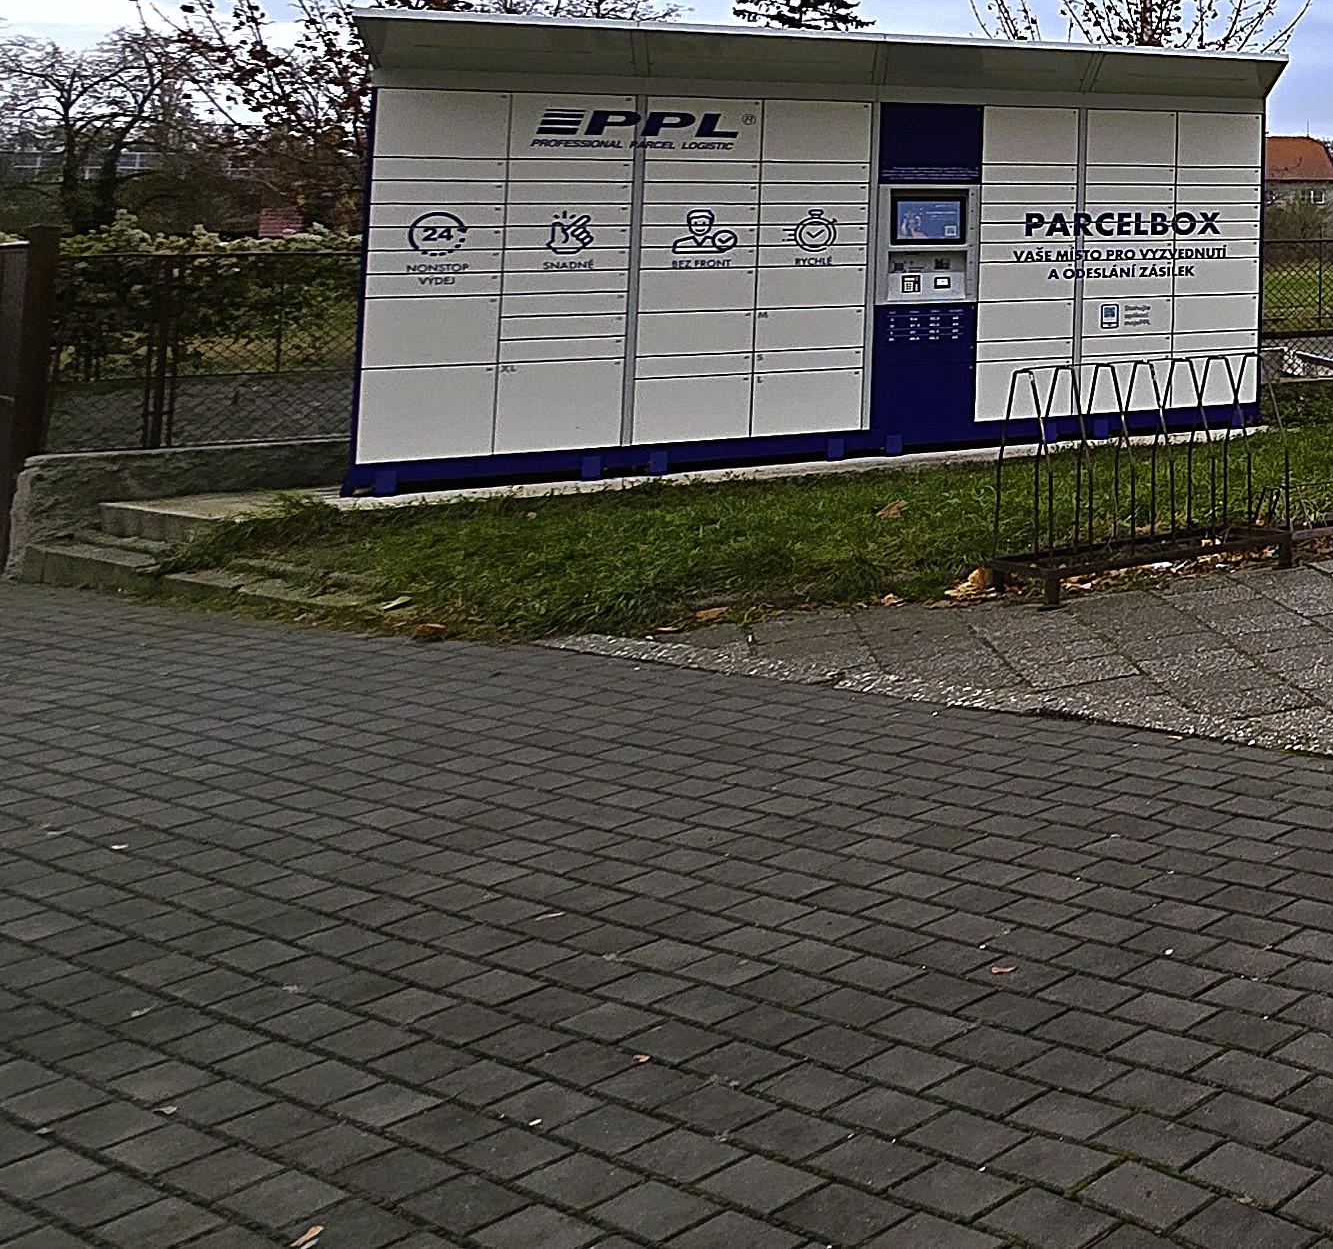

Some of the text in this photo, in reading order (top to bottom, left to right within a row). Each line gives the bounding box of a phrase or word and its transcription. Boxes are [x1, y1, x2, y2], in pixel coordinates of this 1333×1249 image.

[584, 110, 739, 138] PPL
[530, 139, 734, 151] PROFESSIONAL PARCEL LOGISTIC
[1025, 212, 1220, 236] PARCELBOX
[422, 227, 454, 241] 24
[1013, 244, 1228, 262] VAŠE MÍSTO PRO VYZVEDNUTÍ
[543, 259, 594, 269] SNADNÉ
[672, 259, 731, 268] BEZ FRONT
[795, 256, 833, 265] RYCHLÉ
[406, 263, 469, 273] NONSTOP
[1048, 264, 1195, 279] A ODESLÁNÍ ZÁSILEK
[418, 276, 455, 285] VÝDEJ
